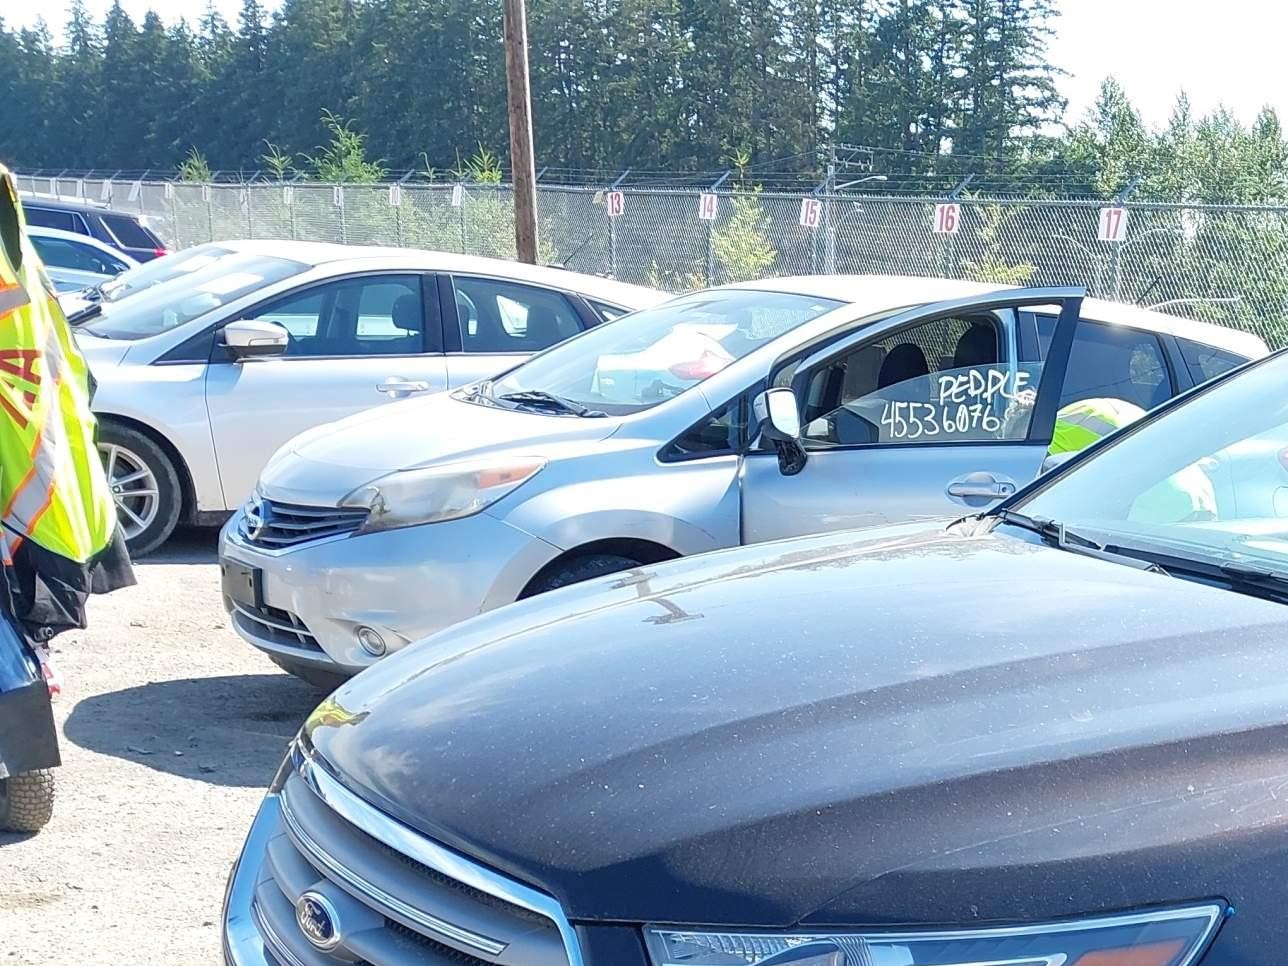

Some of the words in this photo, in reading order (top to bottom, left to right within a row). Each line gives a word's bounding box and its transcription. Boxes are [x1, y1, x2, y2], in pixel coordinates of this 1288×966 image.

[609, 192, 622, 215] 13
[702, 194, 715, 218] 14
[804, 200, 819, 226] 15
[938, 205, 956, 232] 16
[1104, 209, 1123, 240] 17
[880, 400, 1000, 439] 45536076
